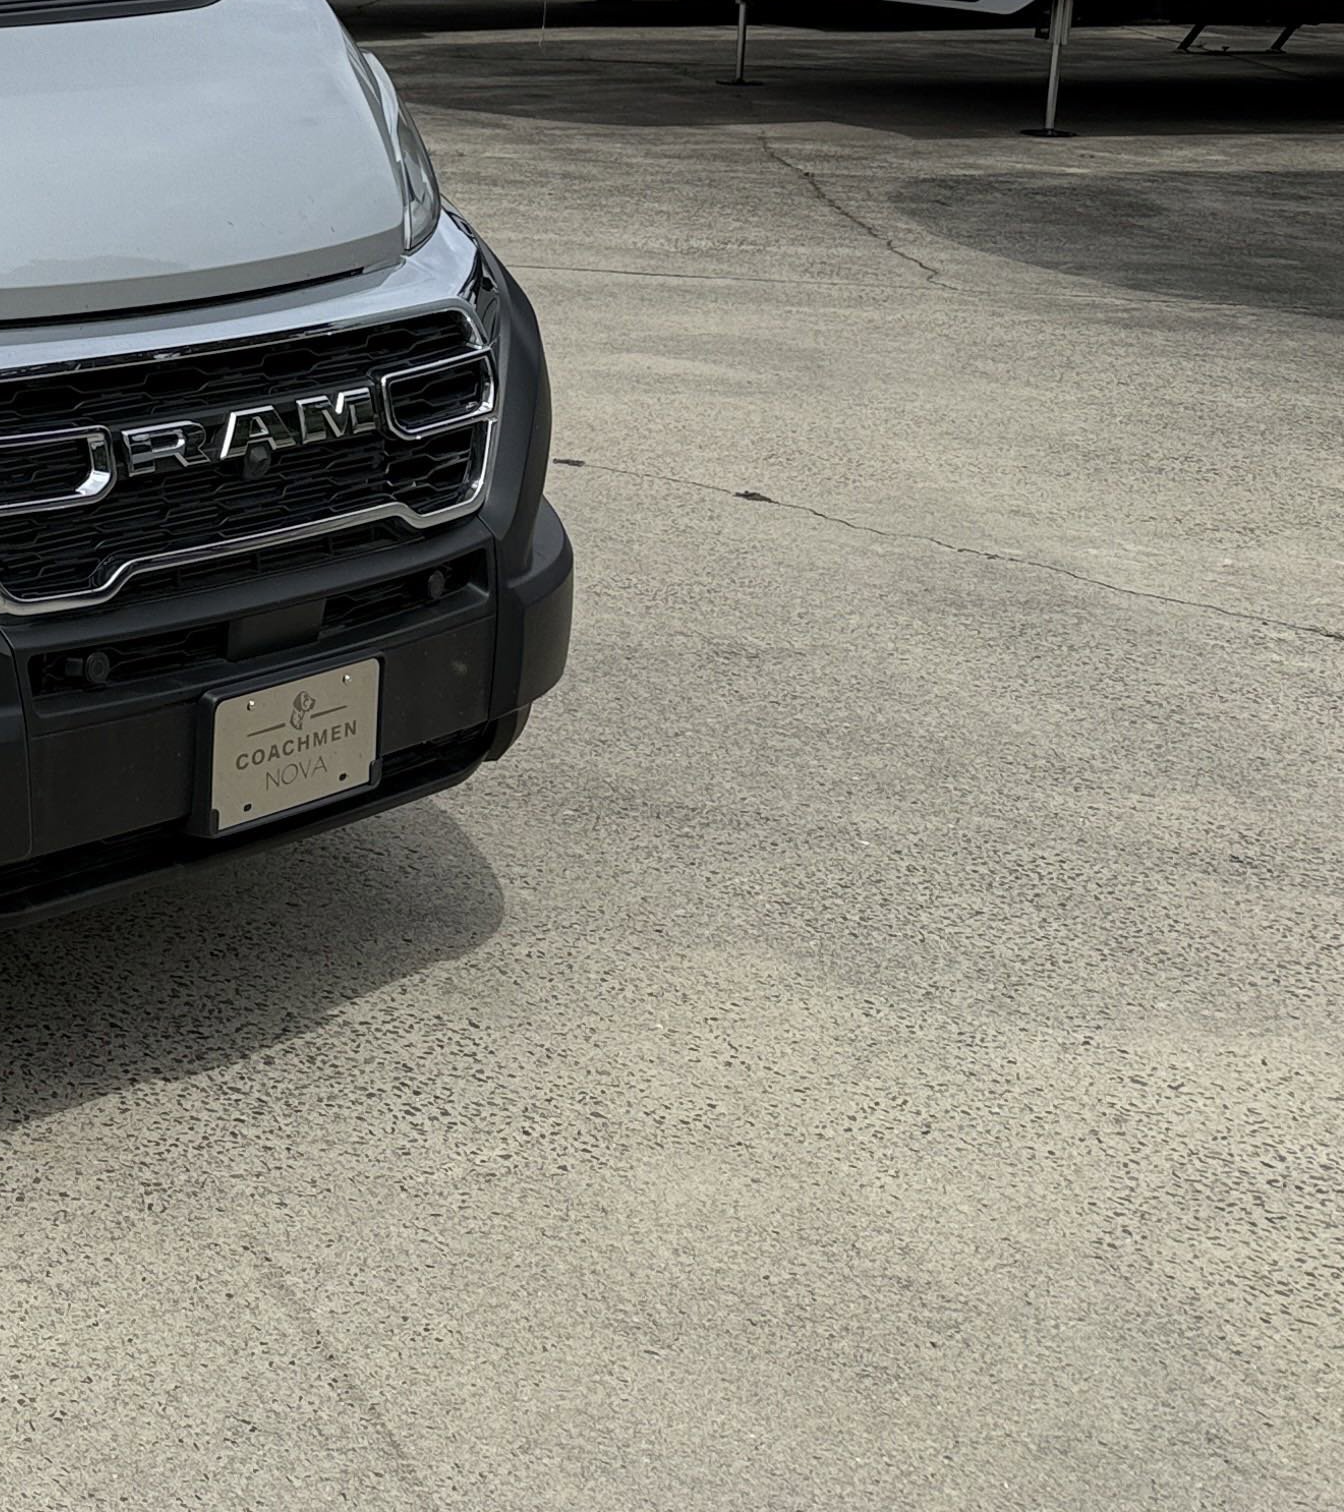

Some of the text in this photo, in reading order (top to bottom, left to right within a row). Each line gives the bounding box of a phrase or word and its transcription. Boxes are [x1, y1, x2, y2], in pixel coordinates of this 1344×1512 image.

[120, 386, 377, 478] RAM
[235, 718, 358, 772] COACHMEN
[265, 755, 329, 791] NOVA
